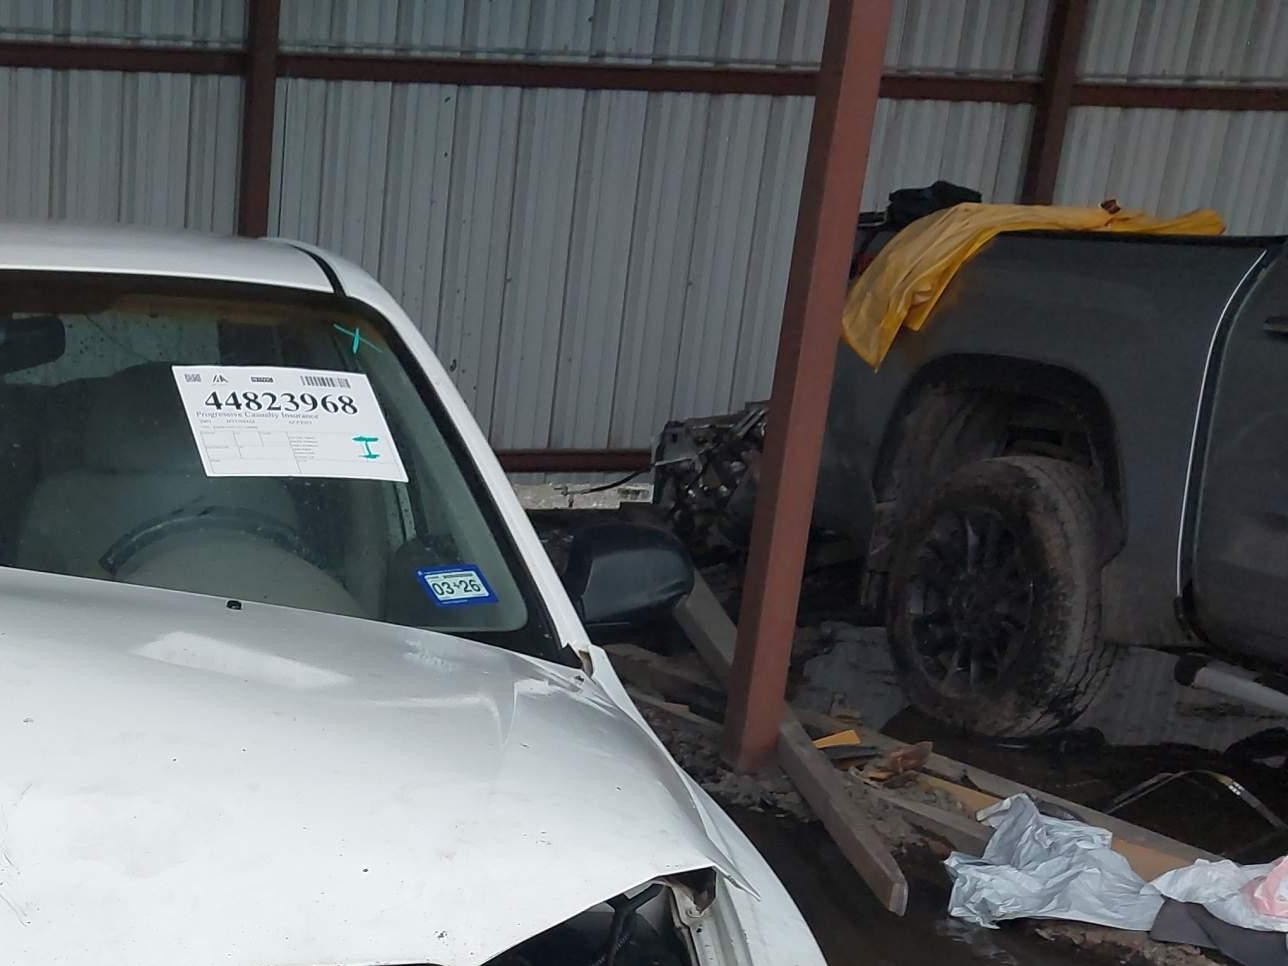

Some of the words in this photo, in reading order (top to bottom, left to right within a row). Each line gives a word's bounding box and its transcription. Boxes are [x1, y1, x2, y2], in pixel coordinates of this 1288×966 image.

[205, 391, 358, 415] 44823968
[196, 411, 243, 419] Progressive
[245, 411, 279, 419] Casualty
